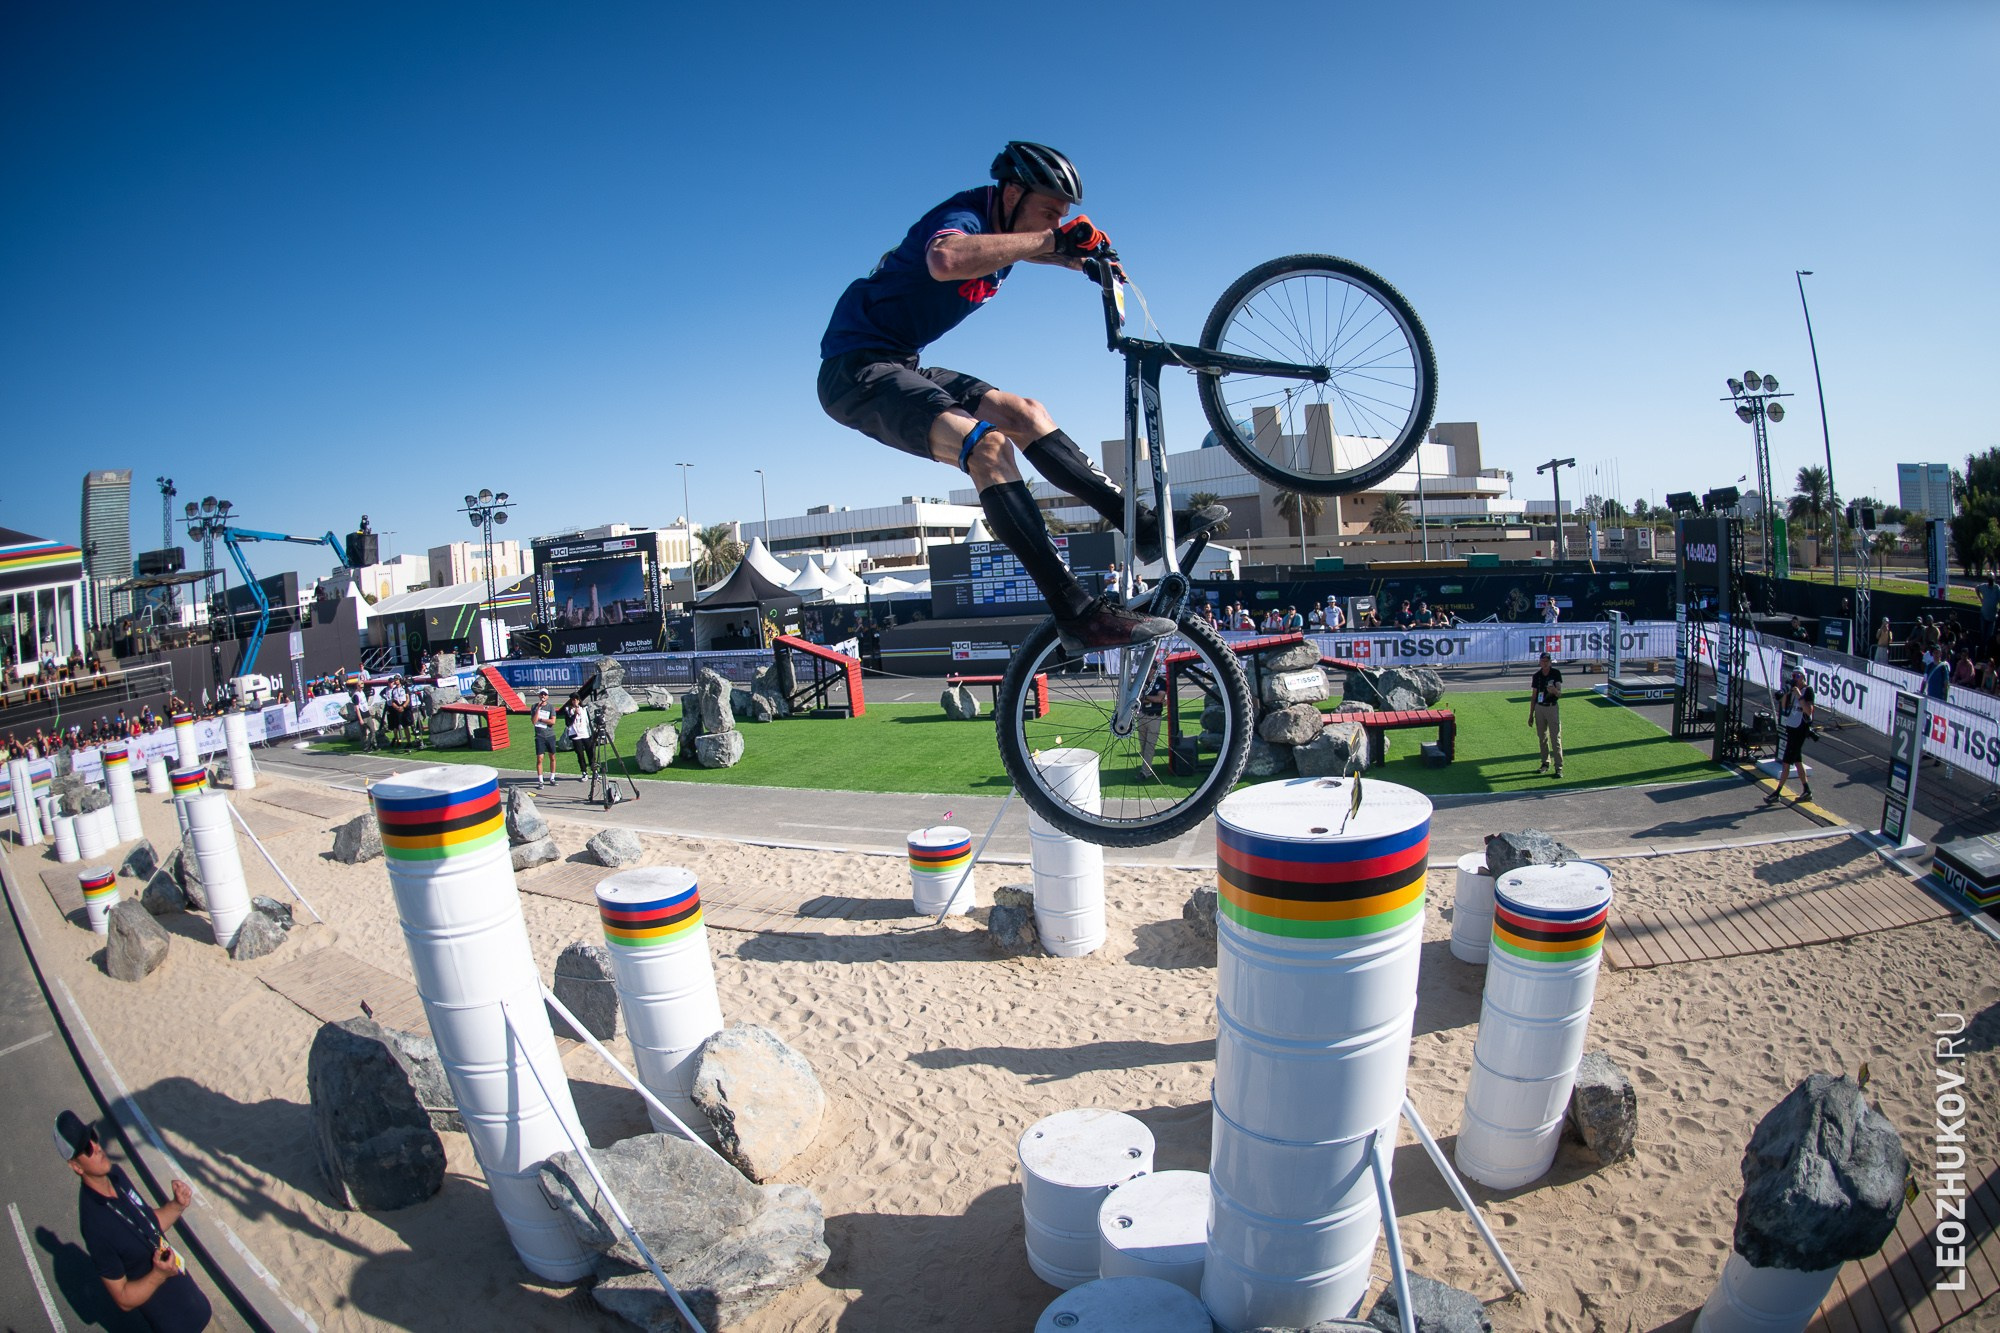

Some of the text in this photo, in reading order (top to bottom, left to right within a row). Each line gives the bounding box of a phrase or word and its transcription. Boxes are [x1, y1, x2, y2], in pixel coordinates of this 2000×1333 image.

[554, 548, 567, 556] UCI
[1686, 543, 1717, 563] 14:40:29
[566, 642, 597, 654] ABU DHABI
[1374, 637, 1470, 657] TISSOT
[514, 668, 570, 682] SHIMANO
[1297, 675, 1320, 686] TISSOT
[1646, 690, 1662, 698] UCI
[1804, 667, 1868, 710] TISSOT
[1895, 715, 1916, 732] START
[1897, 731, 1909, 760] 2
[1946, 867, 1966, 894] UCI
